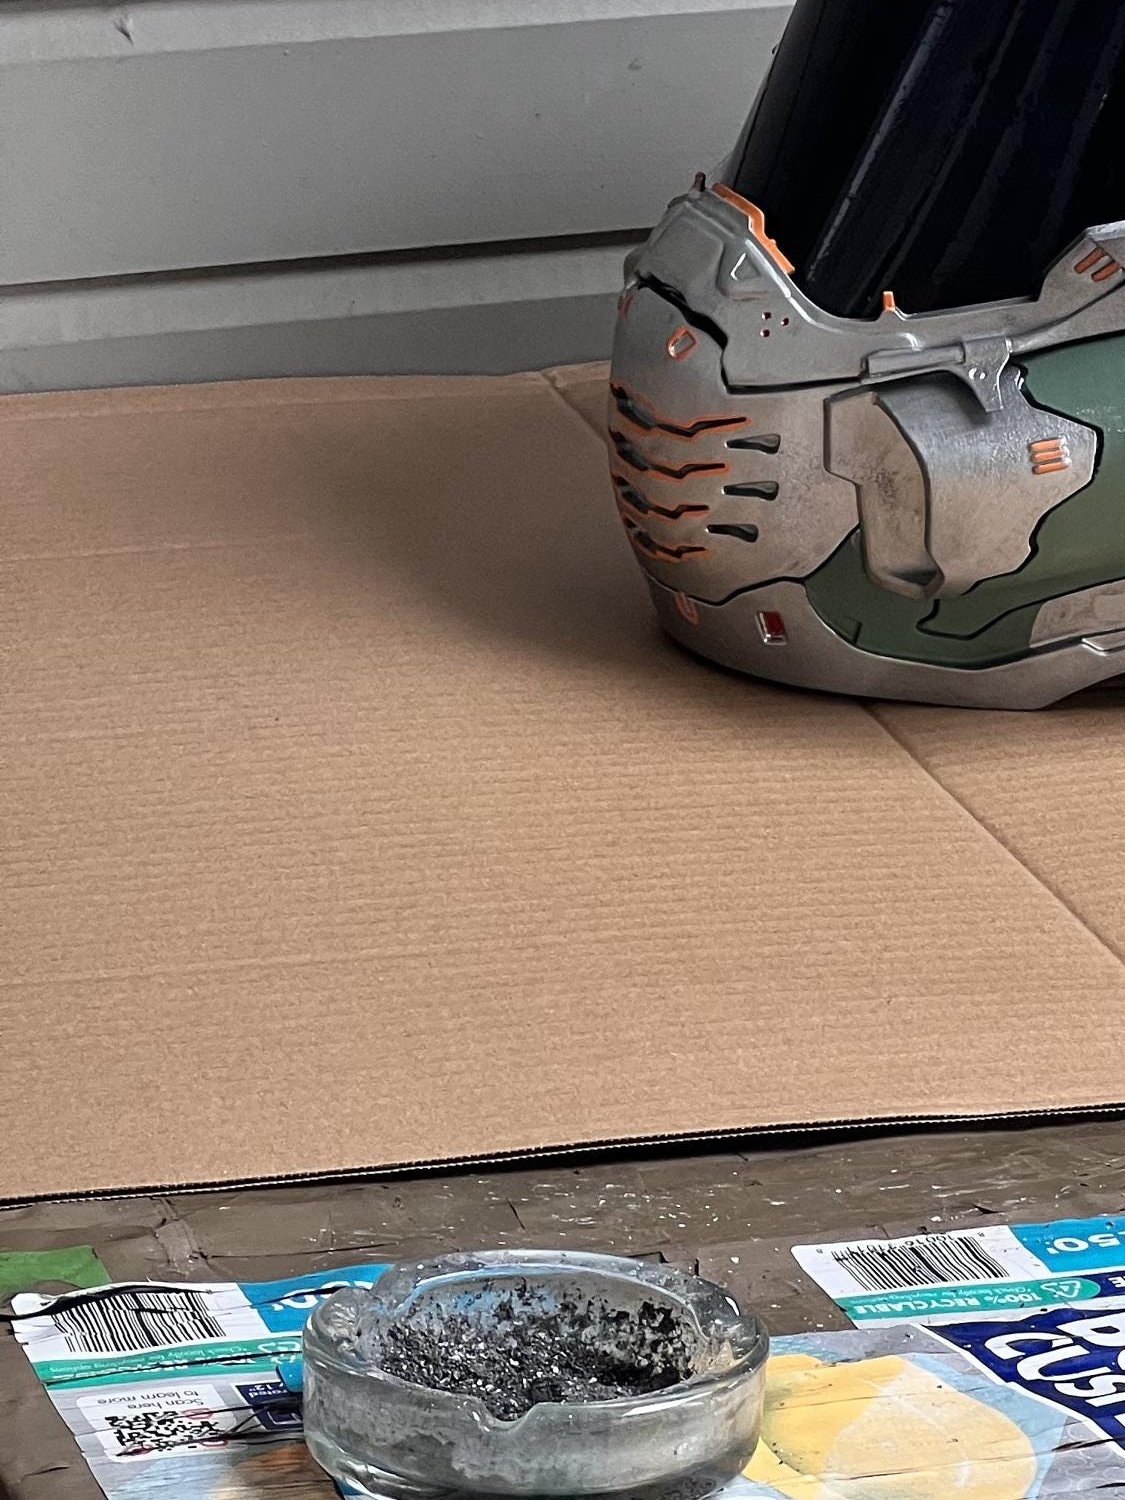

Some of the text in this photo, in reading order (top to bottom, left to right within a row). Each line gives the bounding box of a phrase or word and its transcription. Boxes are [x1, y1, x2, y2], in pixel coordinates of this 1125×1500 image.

[853, 1292, 1043, 1314] 100% RECYCLABLE
[97, 1390, 200, 1405] to learn more
[127, 1397, 205, 1411] Scan here
